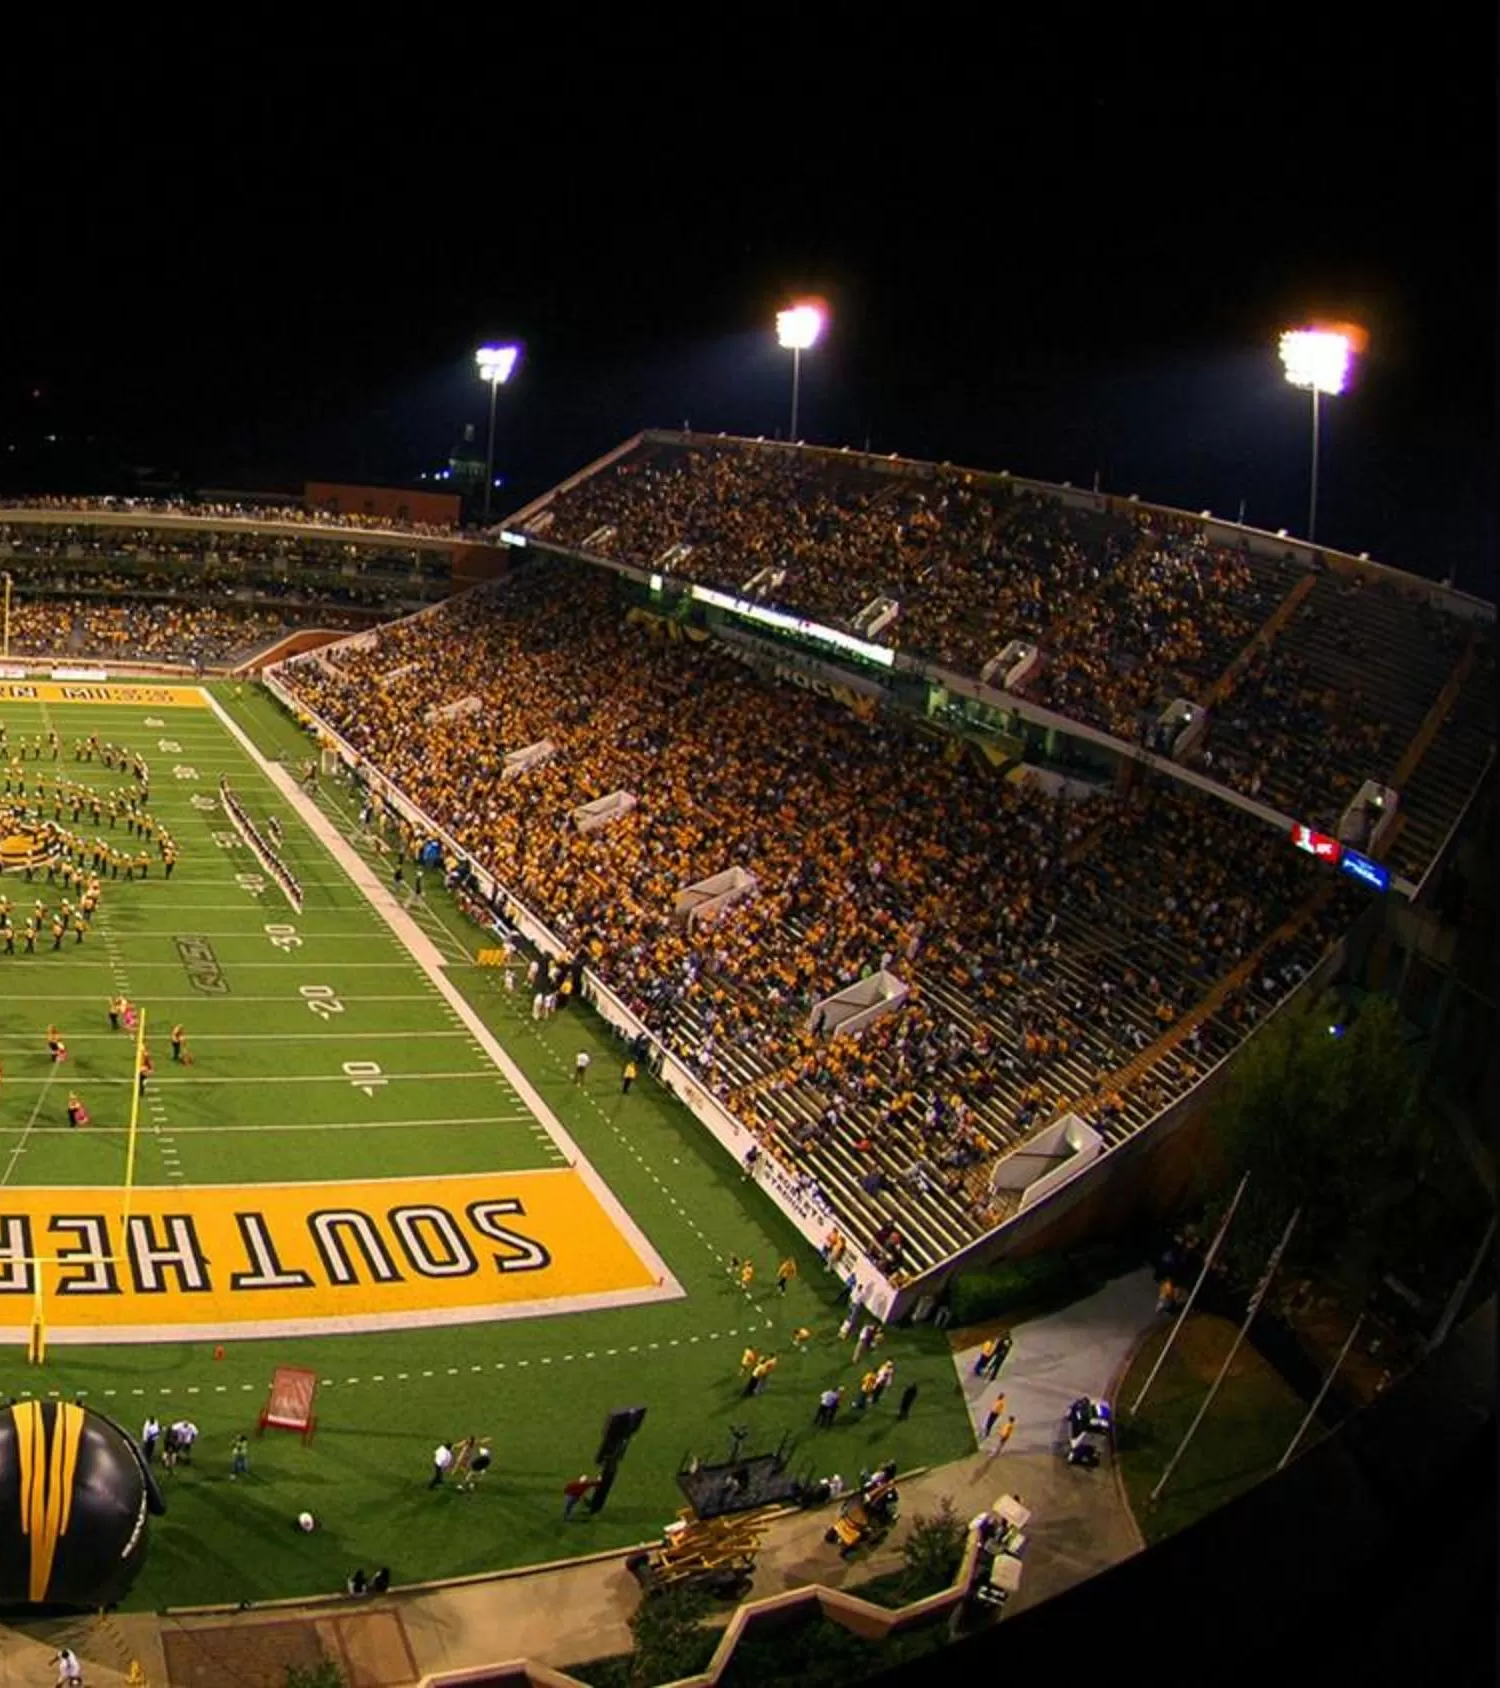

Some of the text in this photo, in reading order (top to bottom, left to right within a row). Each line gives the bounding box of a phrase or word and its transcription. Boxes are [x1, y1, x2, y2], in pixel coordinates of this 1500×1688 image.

[61, 687, 175, 703] MISS
[264, 924, 303, 947] 30
[299, 984, 345, 1013] 20
[342, 1061, 389, 1087] 10
